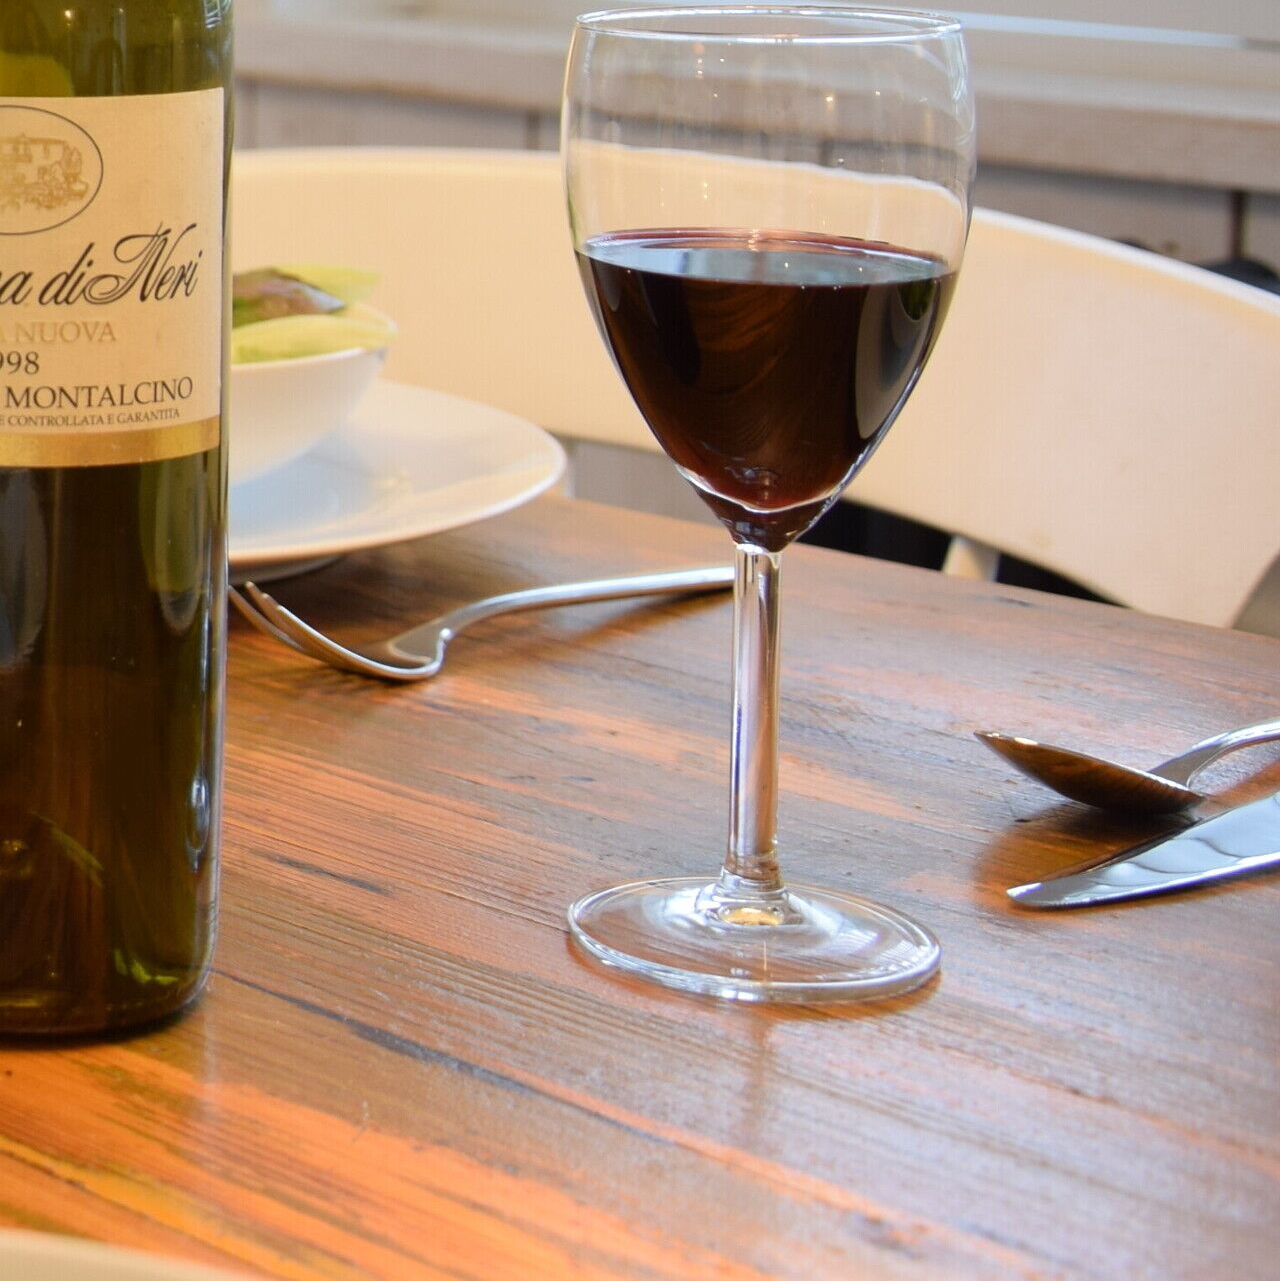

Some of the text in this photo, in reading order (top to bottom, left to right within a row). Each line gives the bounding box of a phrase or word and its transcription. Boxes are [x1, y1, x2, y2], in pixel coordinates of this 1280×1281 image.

[38, 242, 96, 305] di
[83, 221, 203, 305] Neri
[15, 321, 117, 343] NUOVA
[5, 376, 193, 409] MONTALCINO
[8, 415, 104, 427] CONTROLLATA
[107, 413, 116, 425] E
[116, 408, 181, 425] GARANTITA
